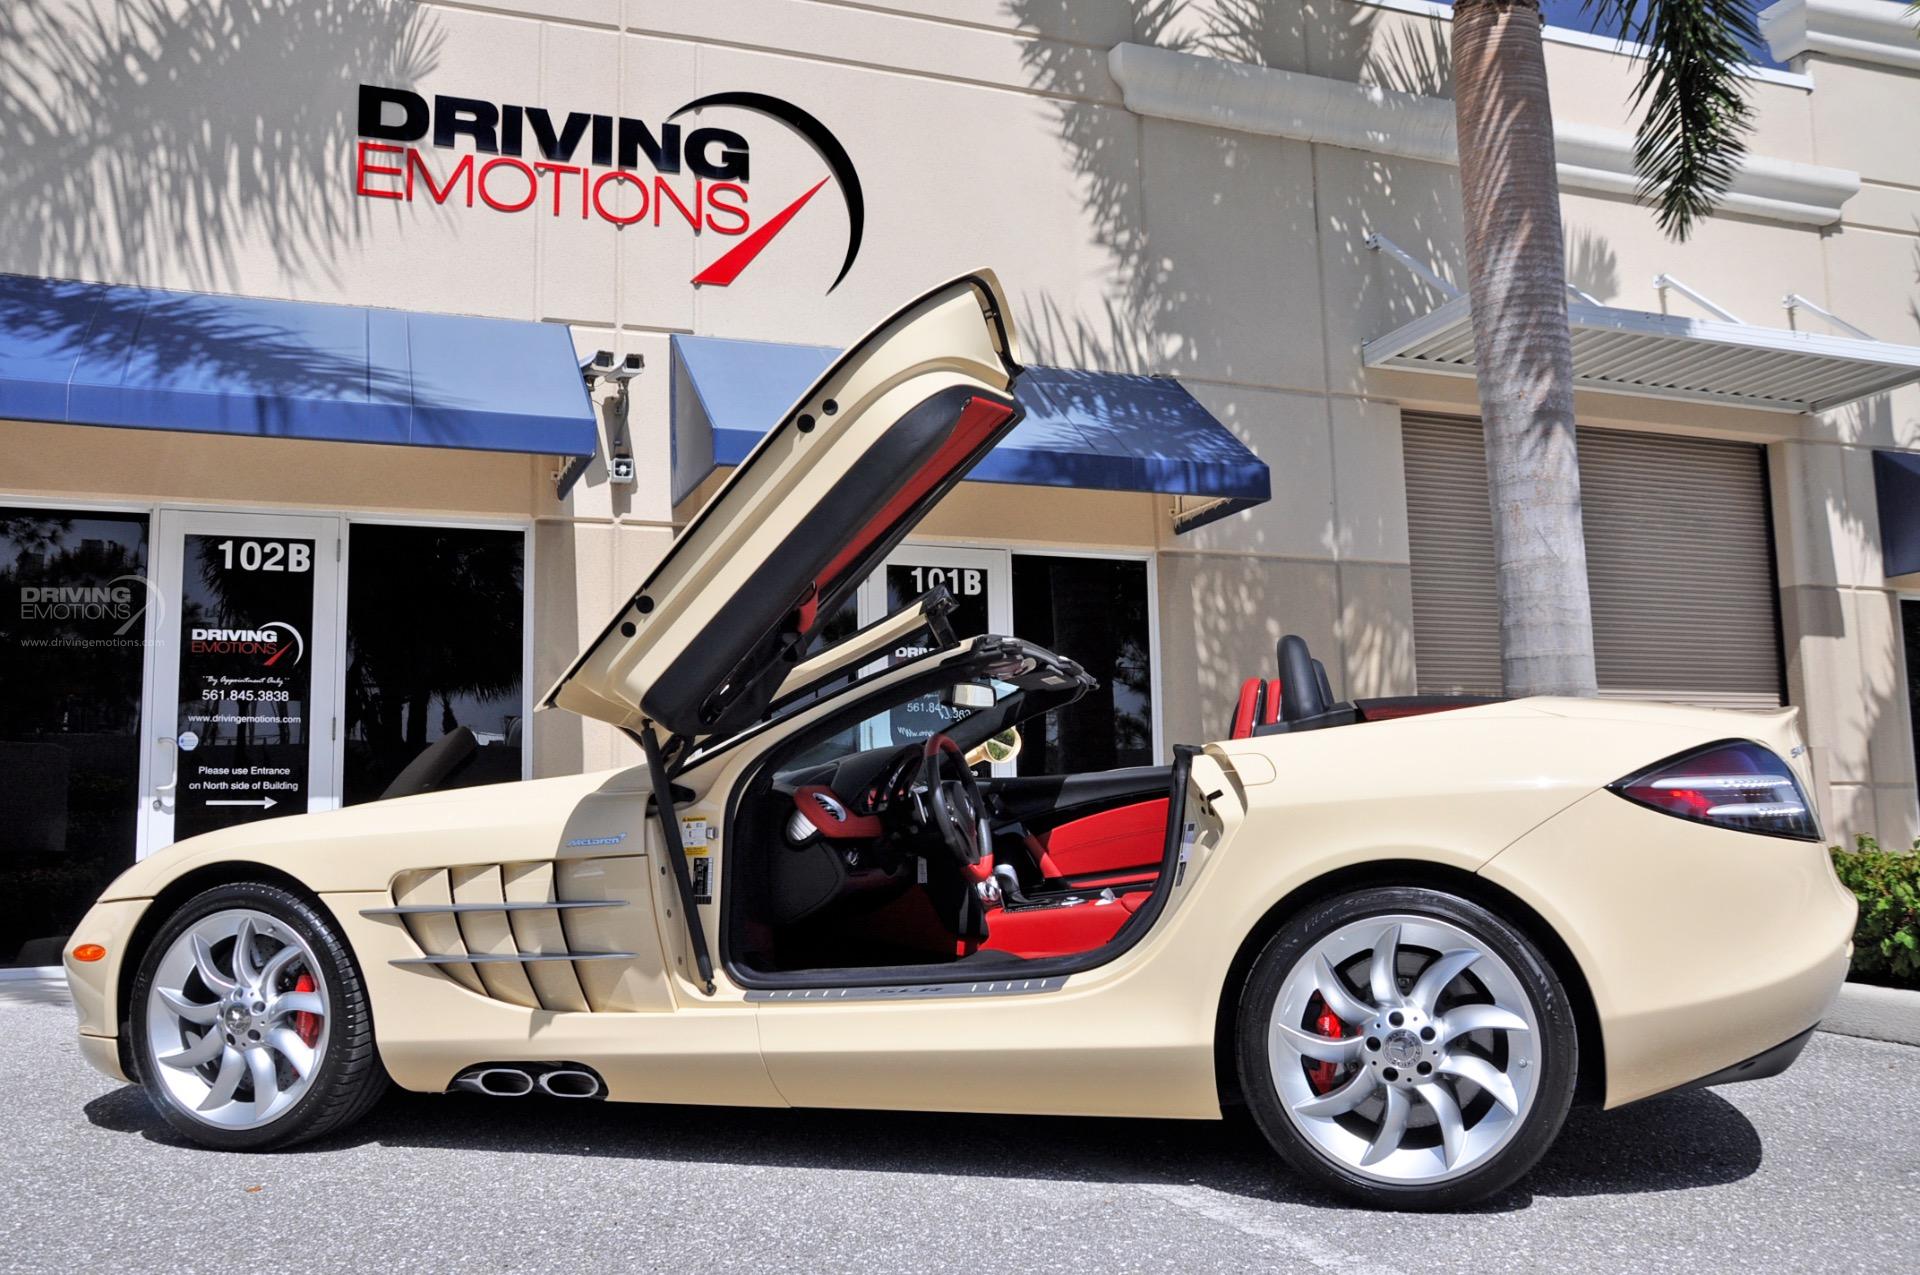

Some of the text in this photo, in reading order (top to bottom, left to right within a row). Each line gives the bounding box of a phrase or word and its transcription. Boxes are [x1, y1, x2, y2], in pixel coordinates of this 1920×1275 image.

[357, 84, 750, 183] DRIVING
[356, 140, 751, 236] EMOTIONS
[217, 539, 311, 573] 102B
[910, 567, 982, 596] 101B
[191, 628, 278, 643] DRIVING
[191, 641, 278, 655] EMOTIONS
[202, 689, 290, 702] 561.845.3838
[187, 713, 301, 725] www.drivingemotions.com
[198, 765, 291, 776] Please use Entrance
[188, 781, 299, 792] on North side of Building
